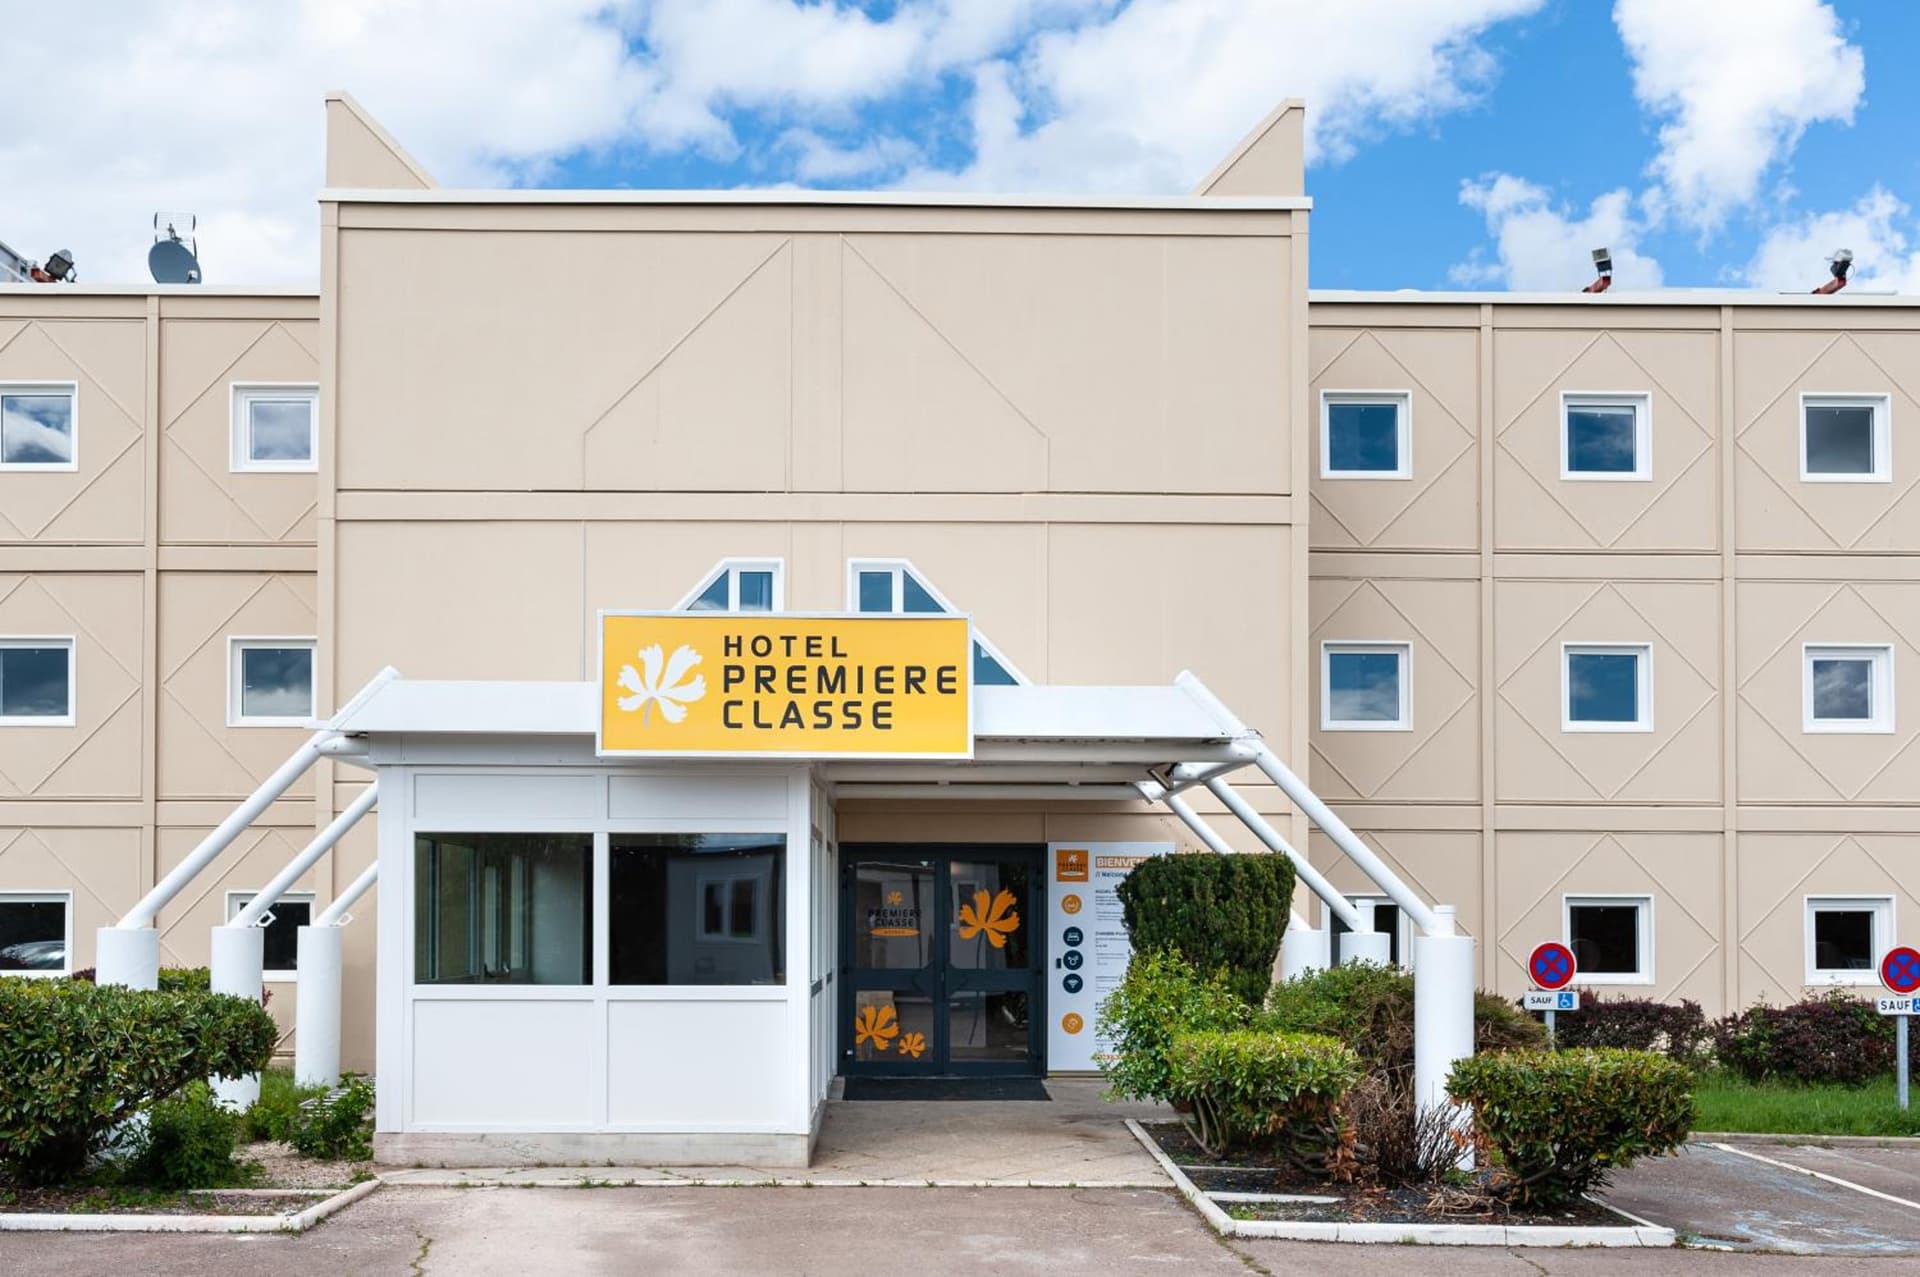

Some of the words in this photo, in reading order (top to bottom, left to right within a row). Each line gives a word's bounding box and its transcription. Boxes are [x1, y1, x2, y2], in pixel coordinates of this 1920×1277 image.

[723, 635, 848, 658] HOTEL
[723, 665, 957, 694] PREMIERE
[723, 700, 893, 729] CLASSE
[1530, 996, 1552, 1004] SAUF
[1880, 1000, 1911, 1010] SAUF
